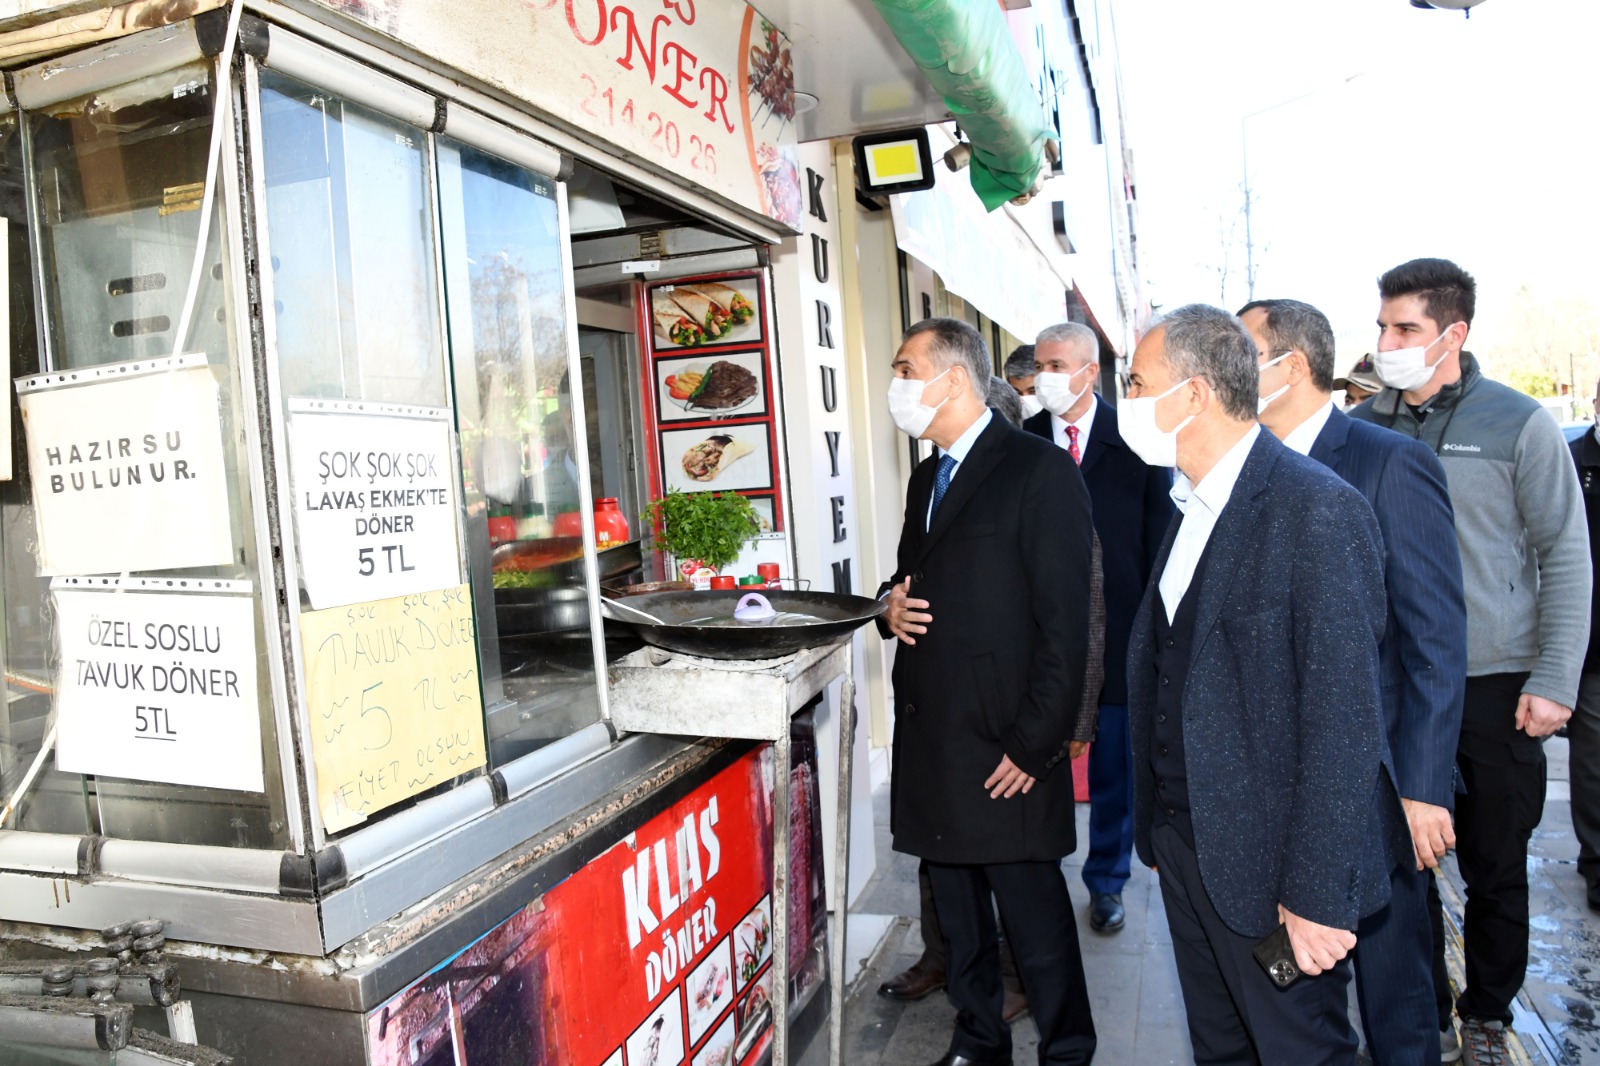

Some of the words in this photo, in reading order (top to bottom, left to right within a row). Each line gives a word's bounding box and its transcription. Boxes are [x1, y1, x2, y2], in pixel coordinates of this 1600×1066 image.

[45, 438, 131, 466] HAZIR
[142, 430, 182, 454] SU
[1449, 443, 1481, 452] Columbia
[50, 459, 197, 494] BULUNUR.
[318, 451, 362, 485] ŞOK
[366, 452, 403, 484] ŞOK
[406, 453, 438, 483] ŞOK
[305, 491, 366, 512] LAVAŞ
[355, 513, 415, 536] DÖNER
[88, 613, 139, 649] ÖZEL
[144, 623, 221, 654] SOSLU
[76, 659, 146, 691] TAVUK
[152, 661, 240, 698] DÖNER
[360, 681, 393, 751] 5
[413, 677, 447, 712] TL
[621, 794, 721, 951] KLAS
[644, 896, 719, 1003] DÖNER
